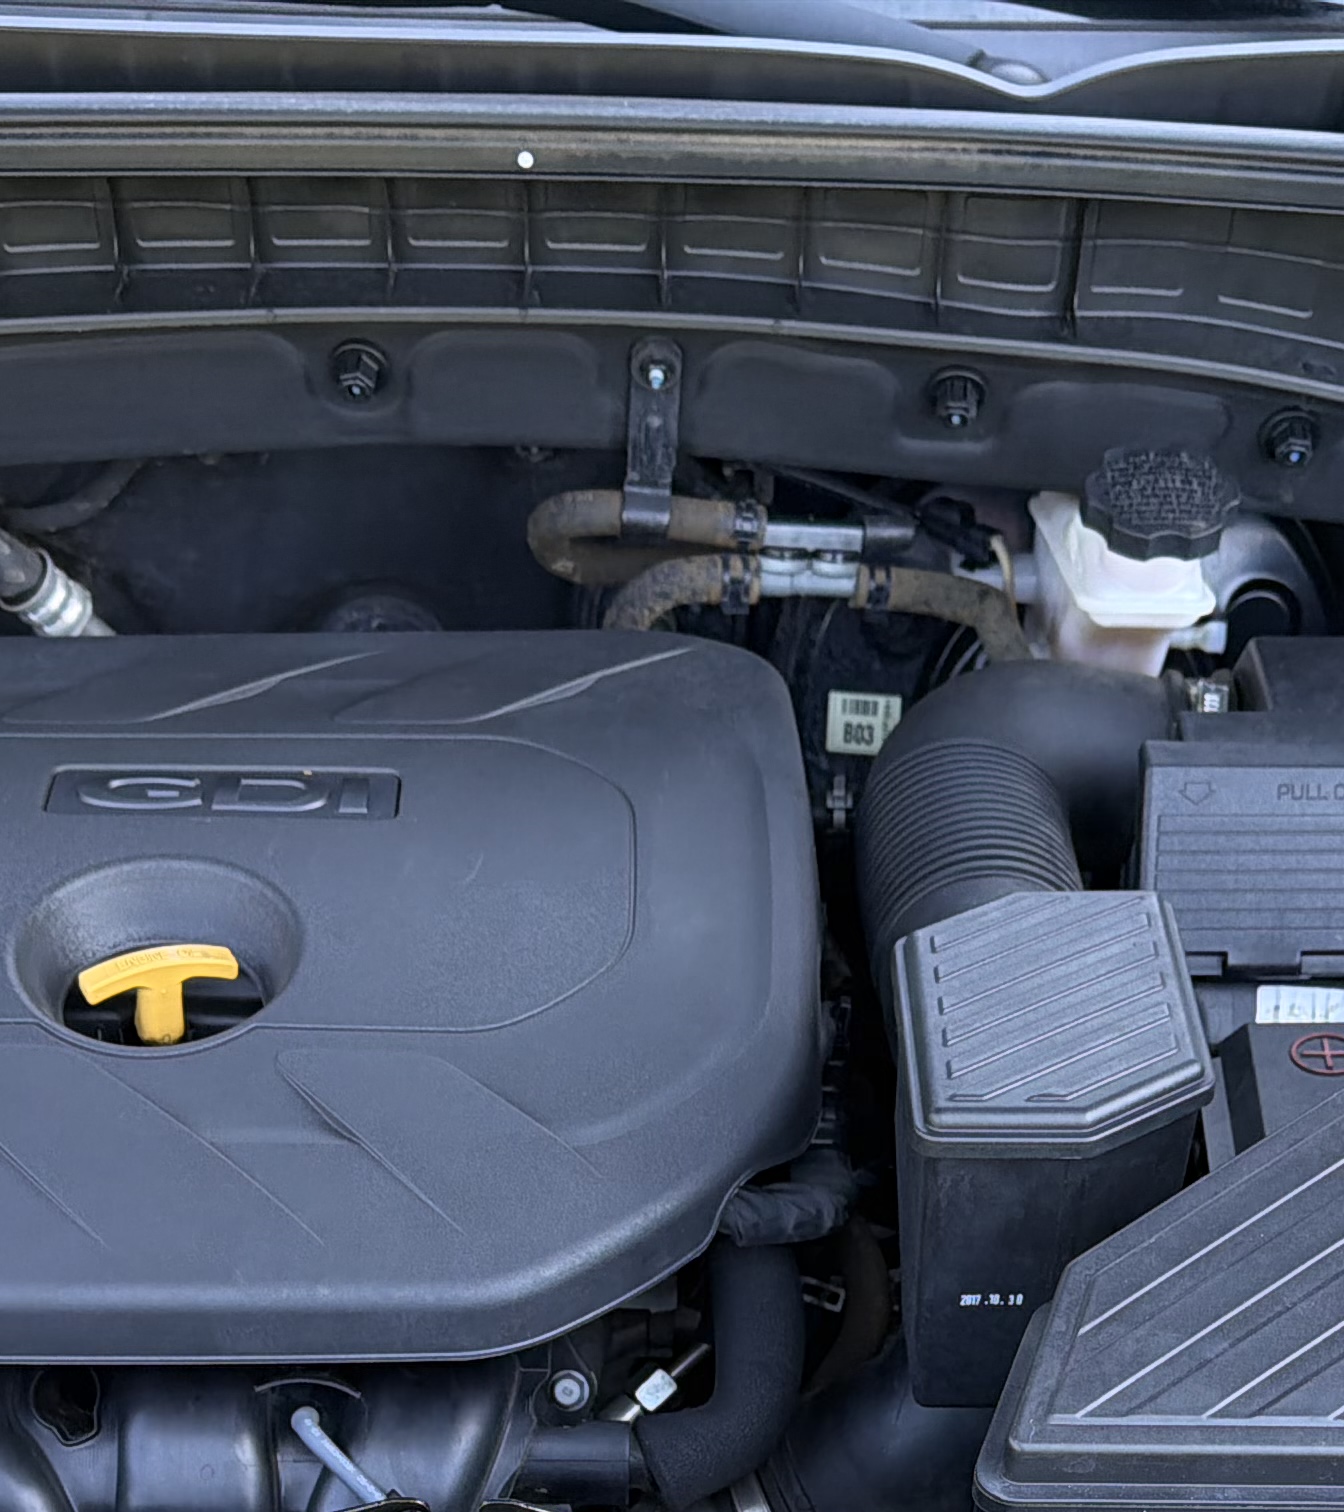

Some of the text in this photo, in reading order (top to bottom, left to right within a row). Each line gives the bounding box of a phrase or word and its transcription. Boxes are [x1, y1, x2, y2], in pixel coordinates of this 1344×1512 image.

[843, 722, 875, 746] B03
[76, 777, 369, 815] GDI
[1277, 782, 1328, 801] PULL
